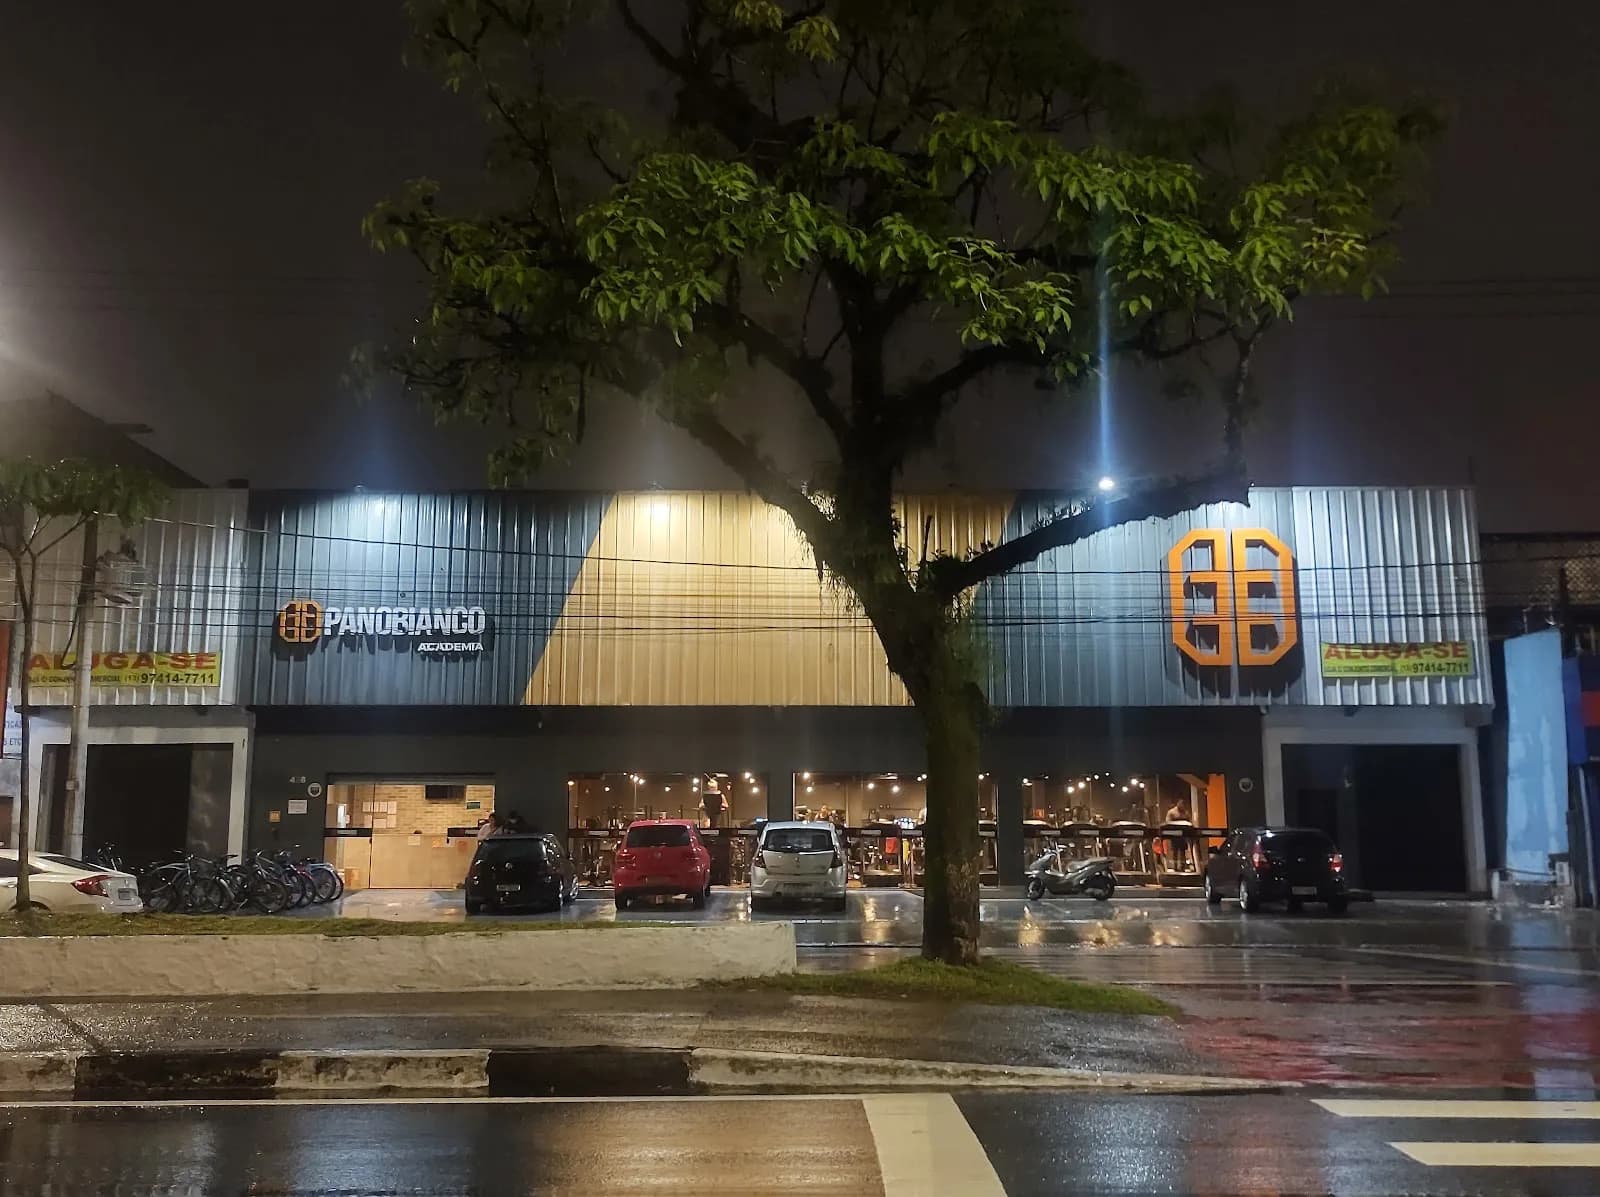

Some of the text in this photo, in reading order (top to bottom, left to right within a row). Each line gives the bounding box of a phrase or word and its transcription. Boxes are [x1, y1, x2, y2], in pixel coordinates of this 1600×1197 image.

[324, 606, 486, 636] PANOBIANCO
[417, 642, 484, 652] ACADEMIA
[1324, 643, 1468, 661] ALUGA-SE
